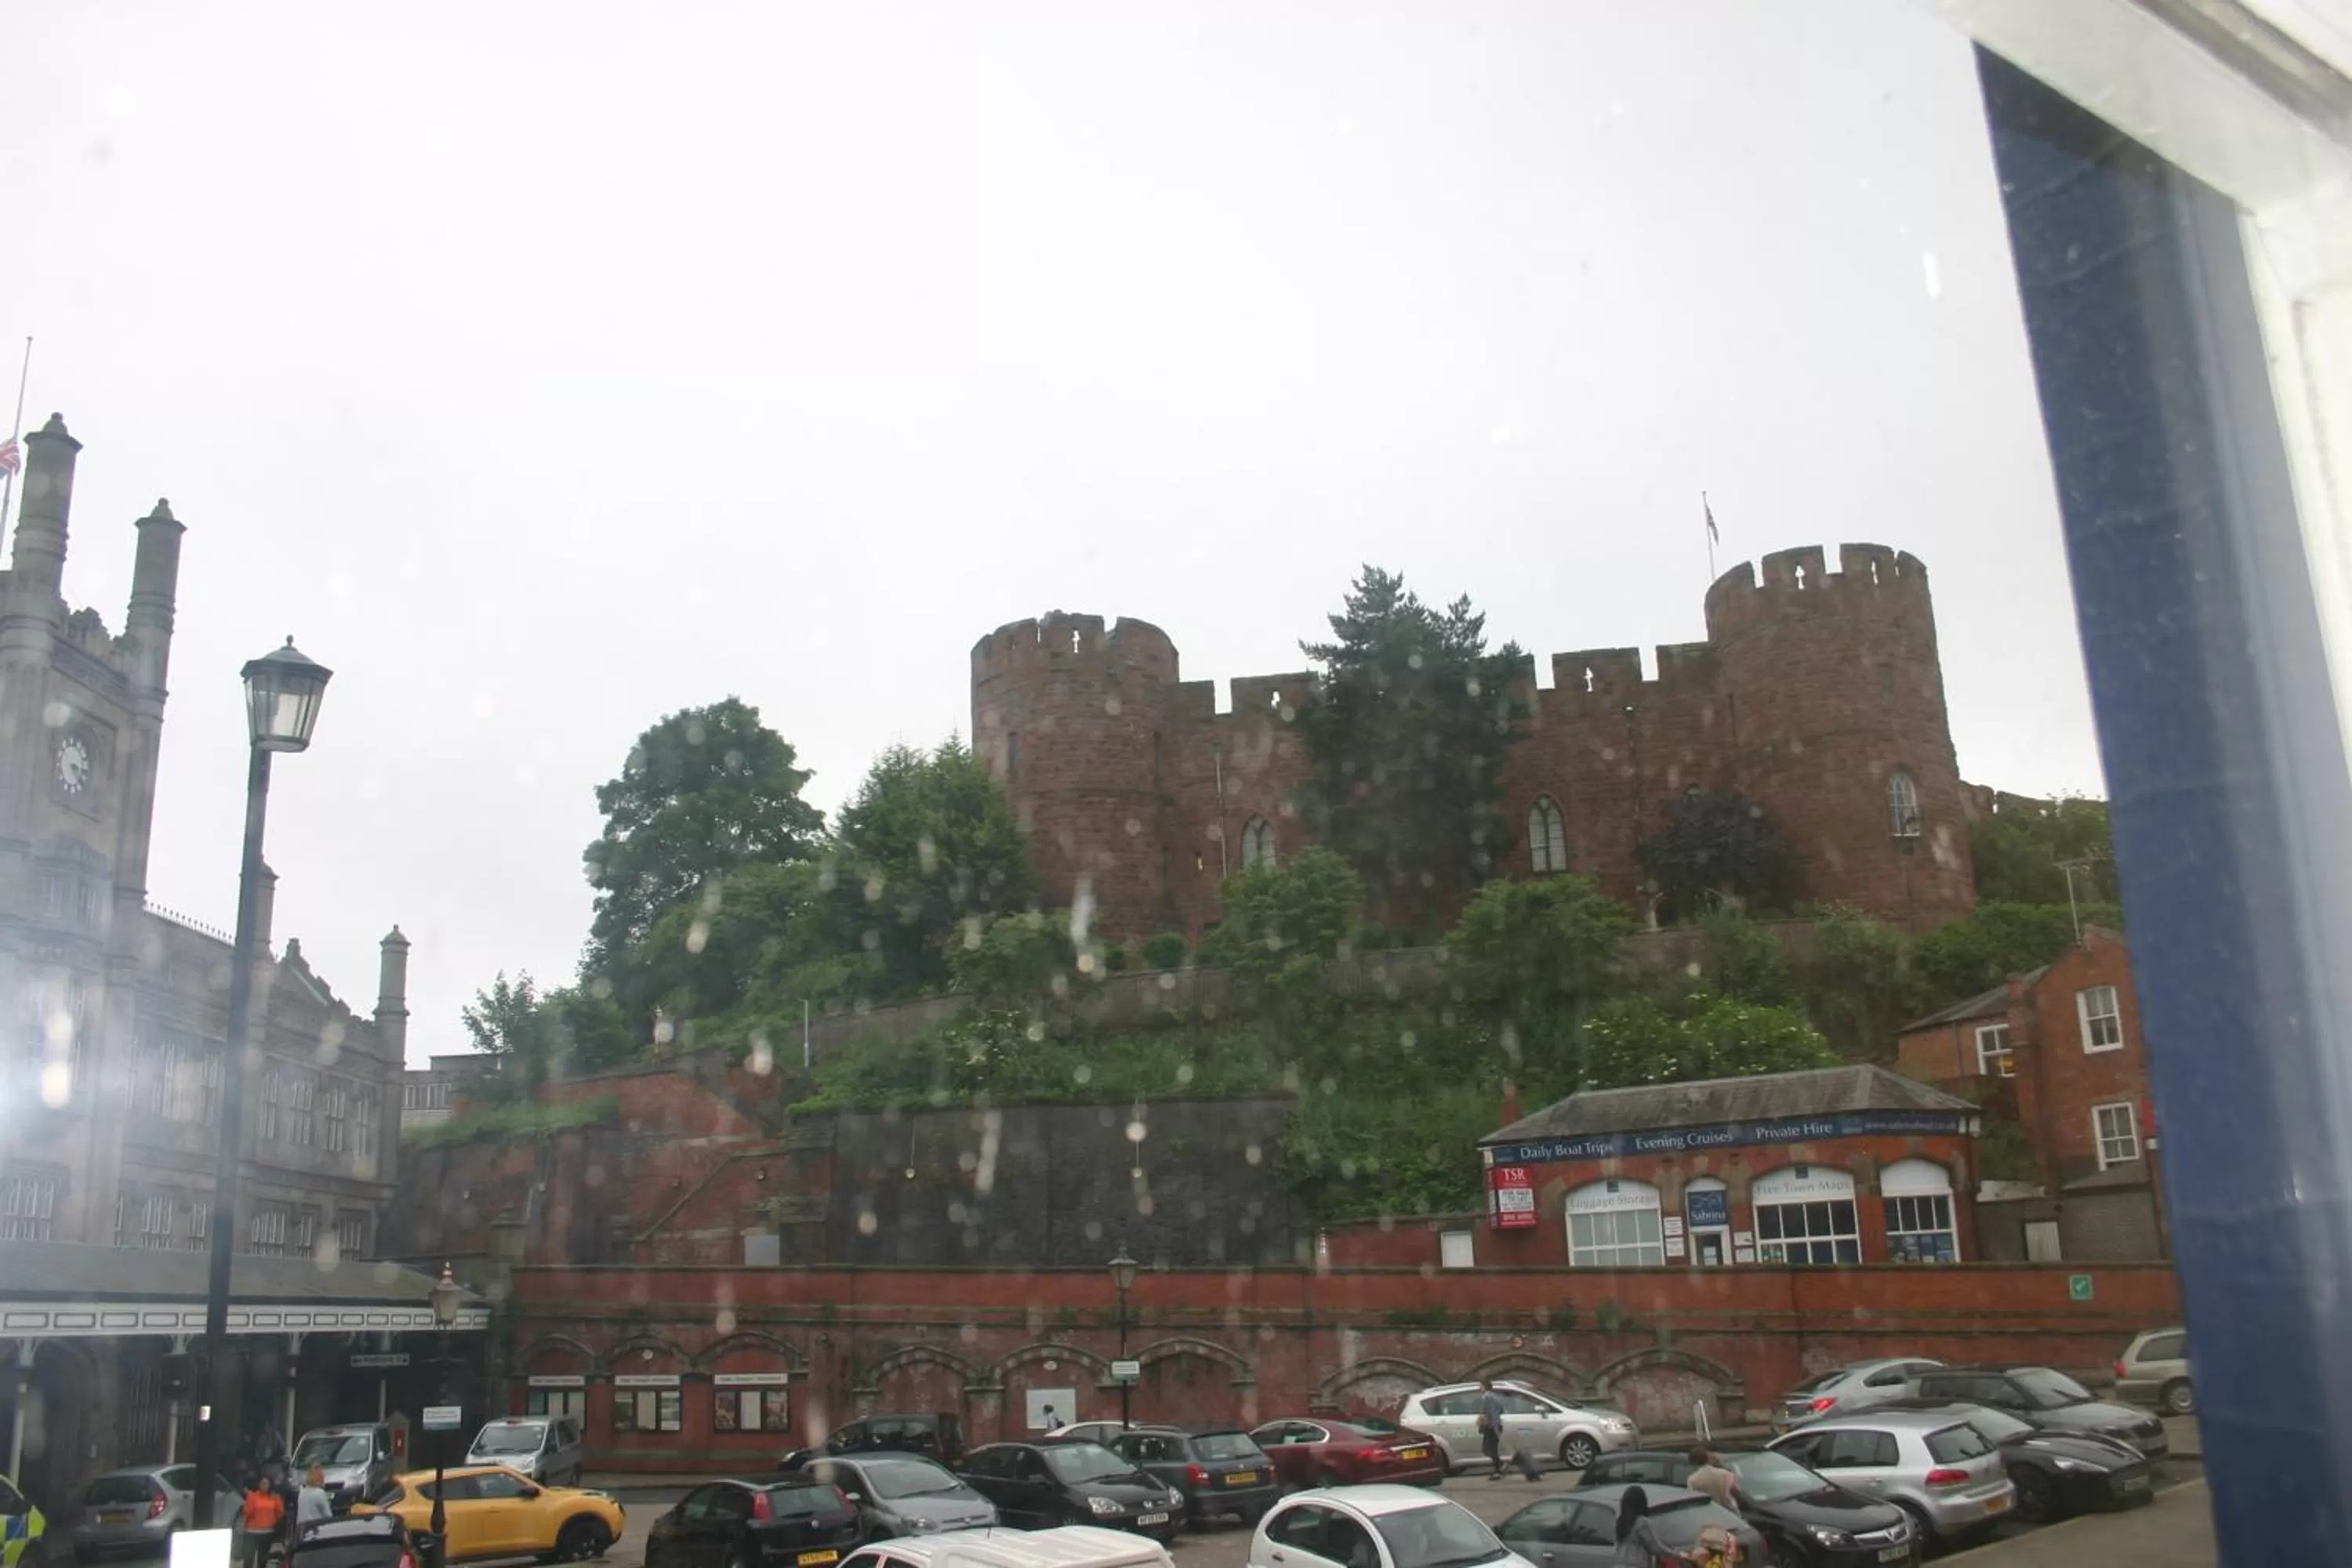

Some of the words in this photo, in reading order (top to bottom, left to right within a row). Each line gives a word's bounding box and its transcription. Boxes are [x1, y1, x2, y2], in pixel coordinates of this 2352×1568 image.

[1756, 1123, 1800, 1140] Private
[1803, 1122, 1833, 1135] Hire
[1635, 1135, 1685, 1151] Evening
[1686, 1130, 1734, 1145] Cruises
[1519, 1145, 1552, 1161] Daily
[1555, 1142, 1583, 1156] Boat
[1585, 1142, 1613, 1156] Trips
[1502, 1167, 1526, 1181] TSR
